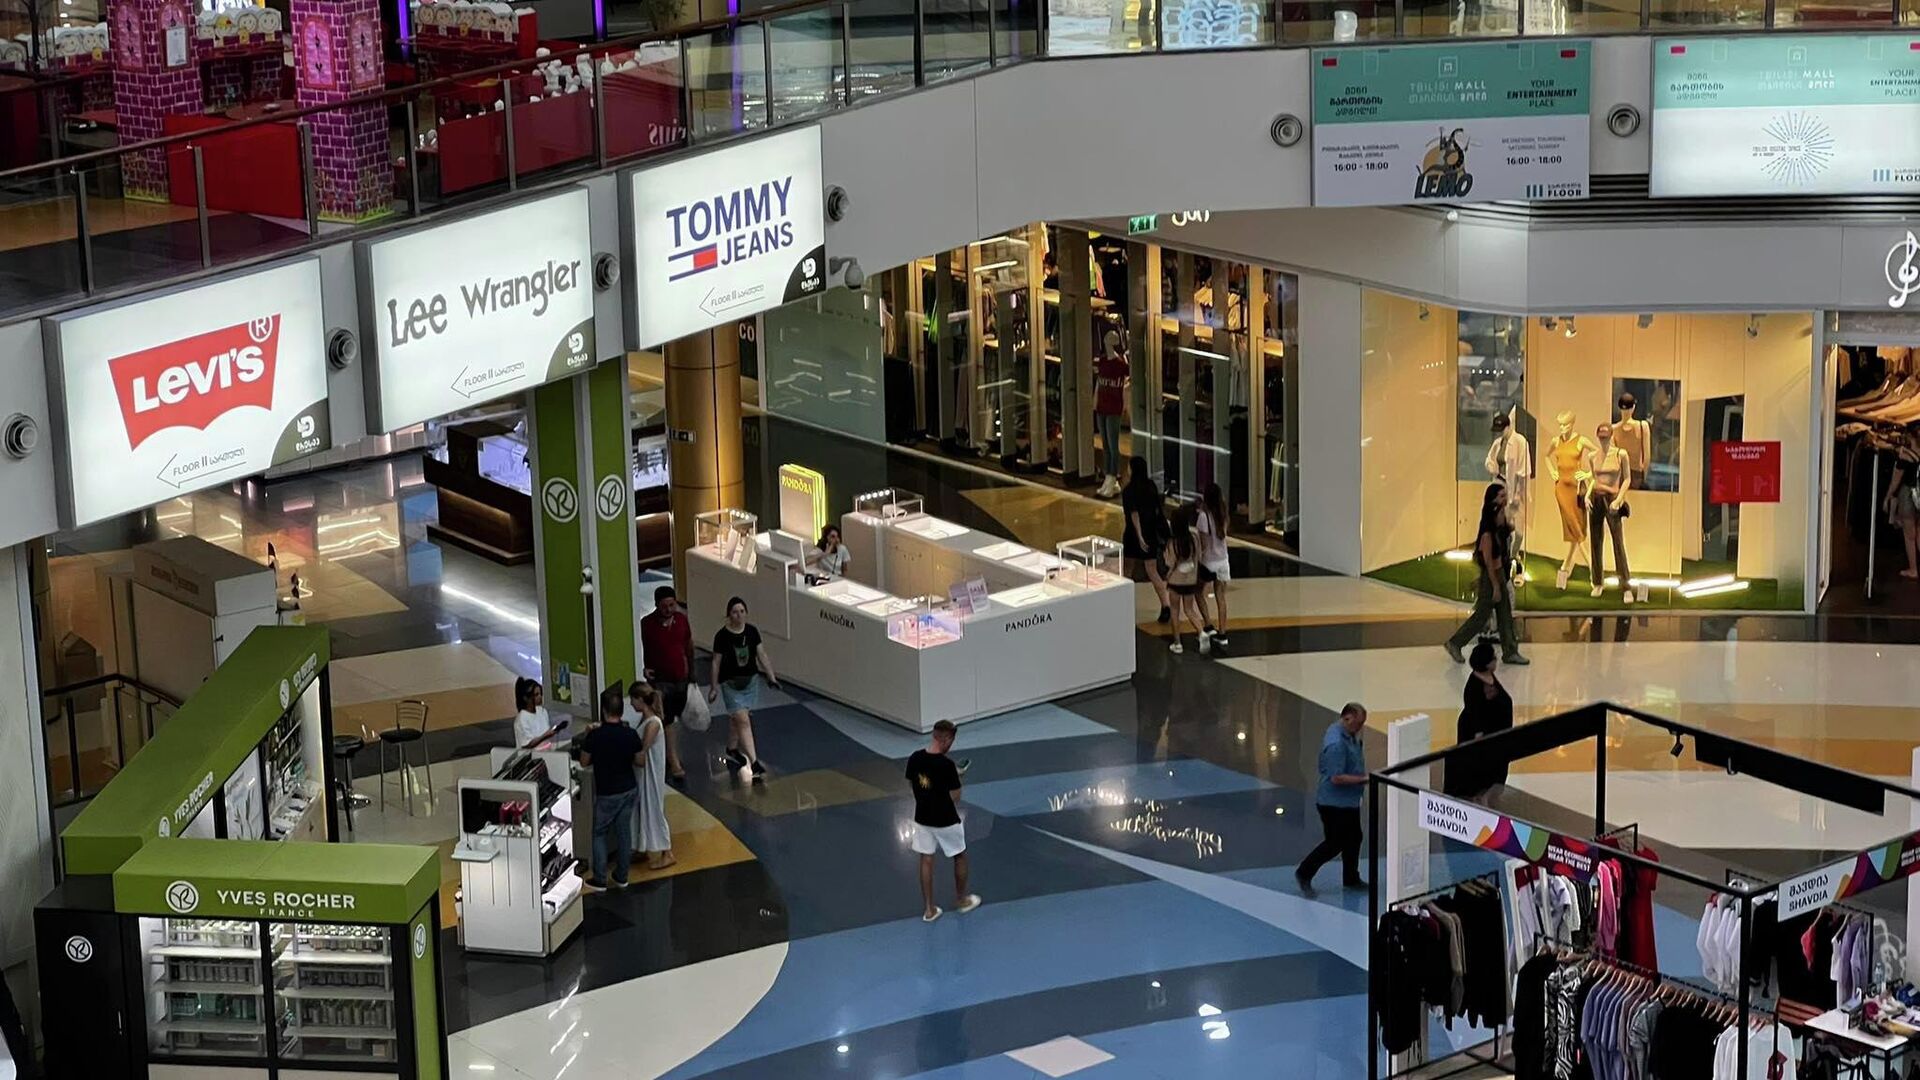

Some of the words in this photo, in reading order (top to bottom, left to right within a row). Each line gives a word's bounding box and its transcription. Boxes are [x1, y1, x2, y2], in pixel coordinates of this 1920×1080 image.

[1803, 69, 1835, 78] MALL
[1454, 80, 1487, 91] MALL
[1530, 79, 1555, 88] YOUR
[1506, 88, 1577, 99] ENTERTAINMENT
[1507, 156, 1530, 165] 16:00
[1539, 155, 1562, 164] 18:00
[1334, 163, 1357, 172] 16:00
[1366, 162, 1389, 170] 18:00
[1547, 189, 1582, 198] FLOOR
[666, 176, 793, 248] TOMMY
[721, 221, 794, 266] JEANS
[387, 293, 448, 348] Lee
[460, 259, 581, 320] Wrangler
[711, 294, 731, 307] FLOOR
[464, 373, 488, 387] FLOOR
[173, 461, 200, 477] FLOOR
[1427, 814, 1468, 836] SHAVDIA
[217, 889, 267, 906] YVES
[273, 891, 356, 909] ROCHER
[1789, 890, 1828, 912] SHAVDIA
[259, 908, 315, 918] FRANCE
